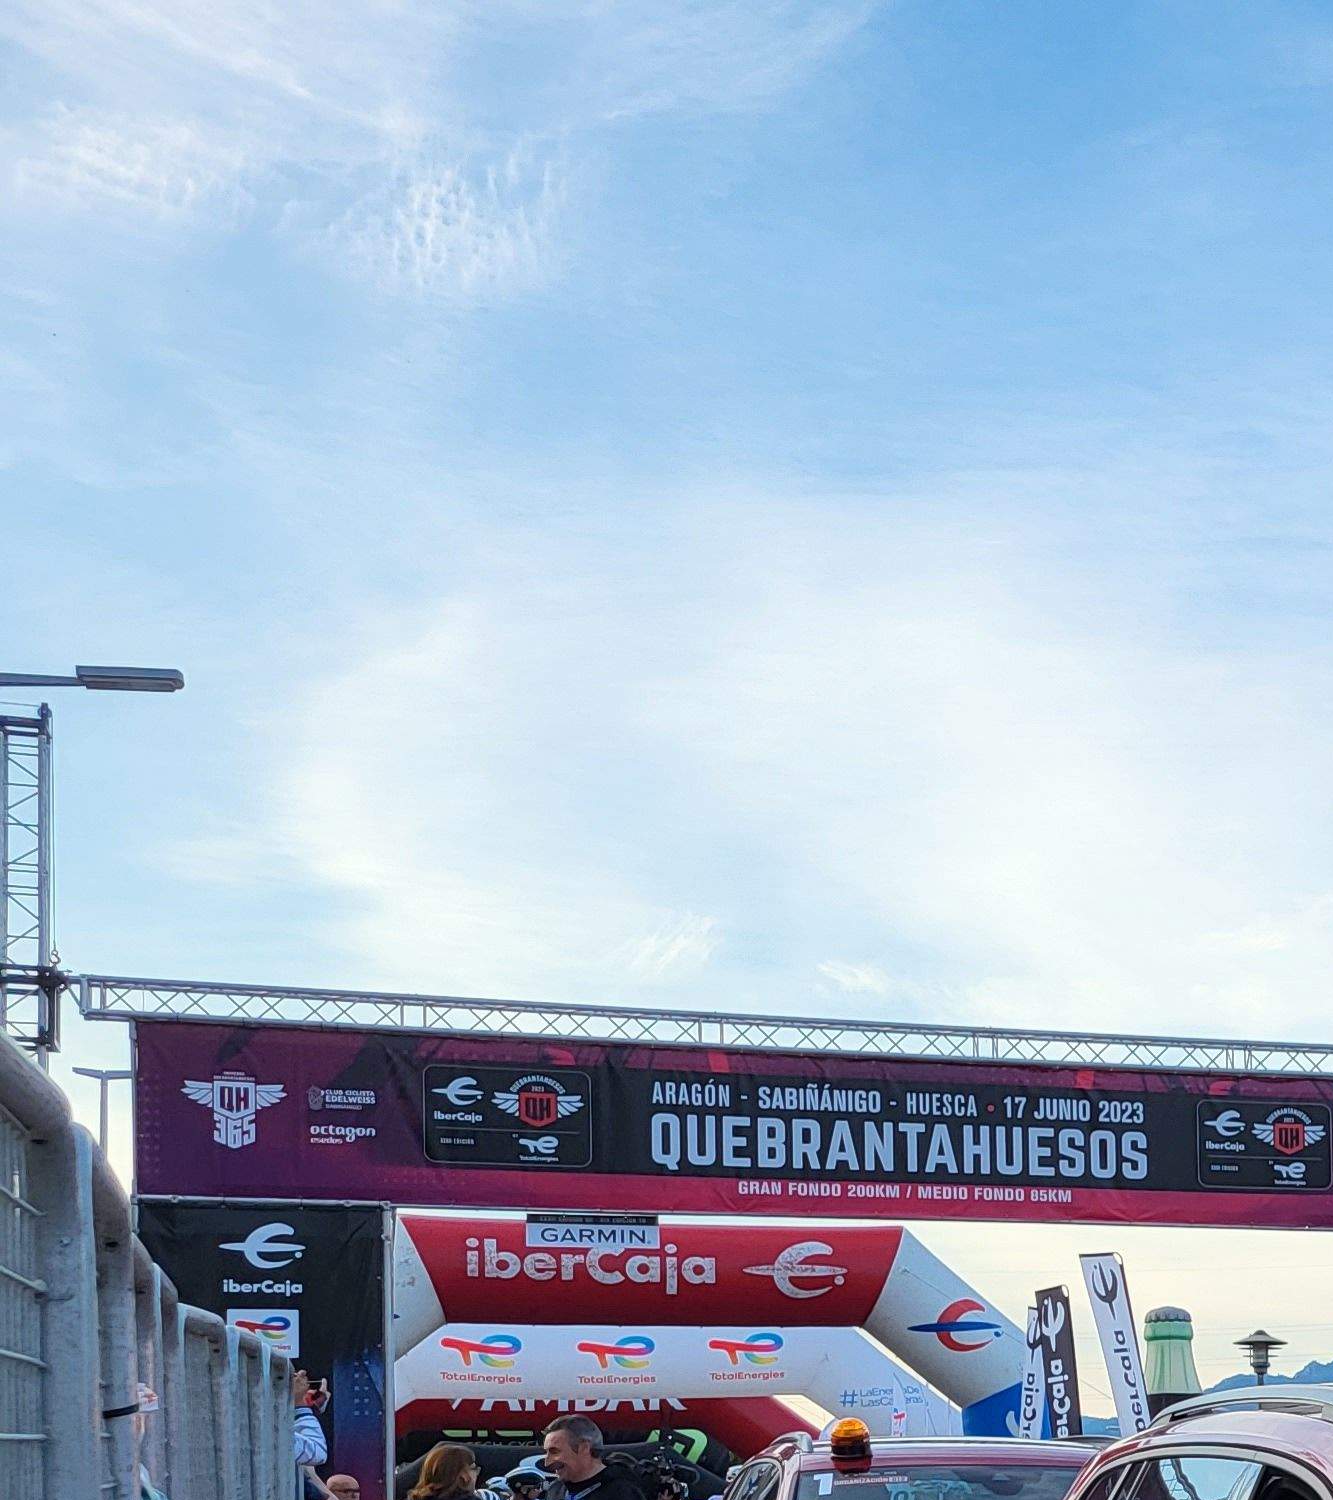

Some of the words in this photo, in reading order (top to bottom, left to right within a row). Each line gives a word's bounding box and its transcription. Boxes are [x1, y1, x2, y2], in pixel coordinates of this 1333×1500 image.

[325, 1096, 376, 1105] EDELWEISS
[652, 1079, 730, 1107] ARAGÓN
[758, 1083, 881, 1113] SABIÑÁNIGO
[906, 1092, 978, 1117] HUESCA
[1003, 1096, 1027, 1119] 17
[1034, 1098, 1090, 1122] JUNIO
[1099, 1101, 1144, 1124] 2023
[433, 1110, 483, 1123] iberCaja
[213, 1112, 256, 1149] 365
[310, 1125, 376, 1143] octagon
[651, 1112, 1147, 1180] QUEBRANTAHUESOS
[738, 1181, 781, 1195] GRAN
[788, 1182, 841, 1197] FONDO
[848, 1184, 900, 1198] 200KM
[918, 1185, 967, 1200] MEDIO
[974, 1187, 1025, 1202] FONDO
[1030, 1189, 1072, 1203] 85KM
[540, 1227, 647, 1243] GARMIN
[465, 1237, 716, 1295] iberCaja
[222, 1279, 303, 1297] iberCaja
[440, 1372, 522, 1384] TotalEnergies
[577, 1374, 656, 1385] TotalEnergies
[709, 1371, 785, 1381] TotalEnergies
[813, 1473, 834, 1496] 1
